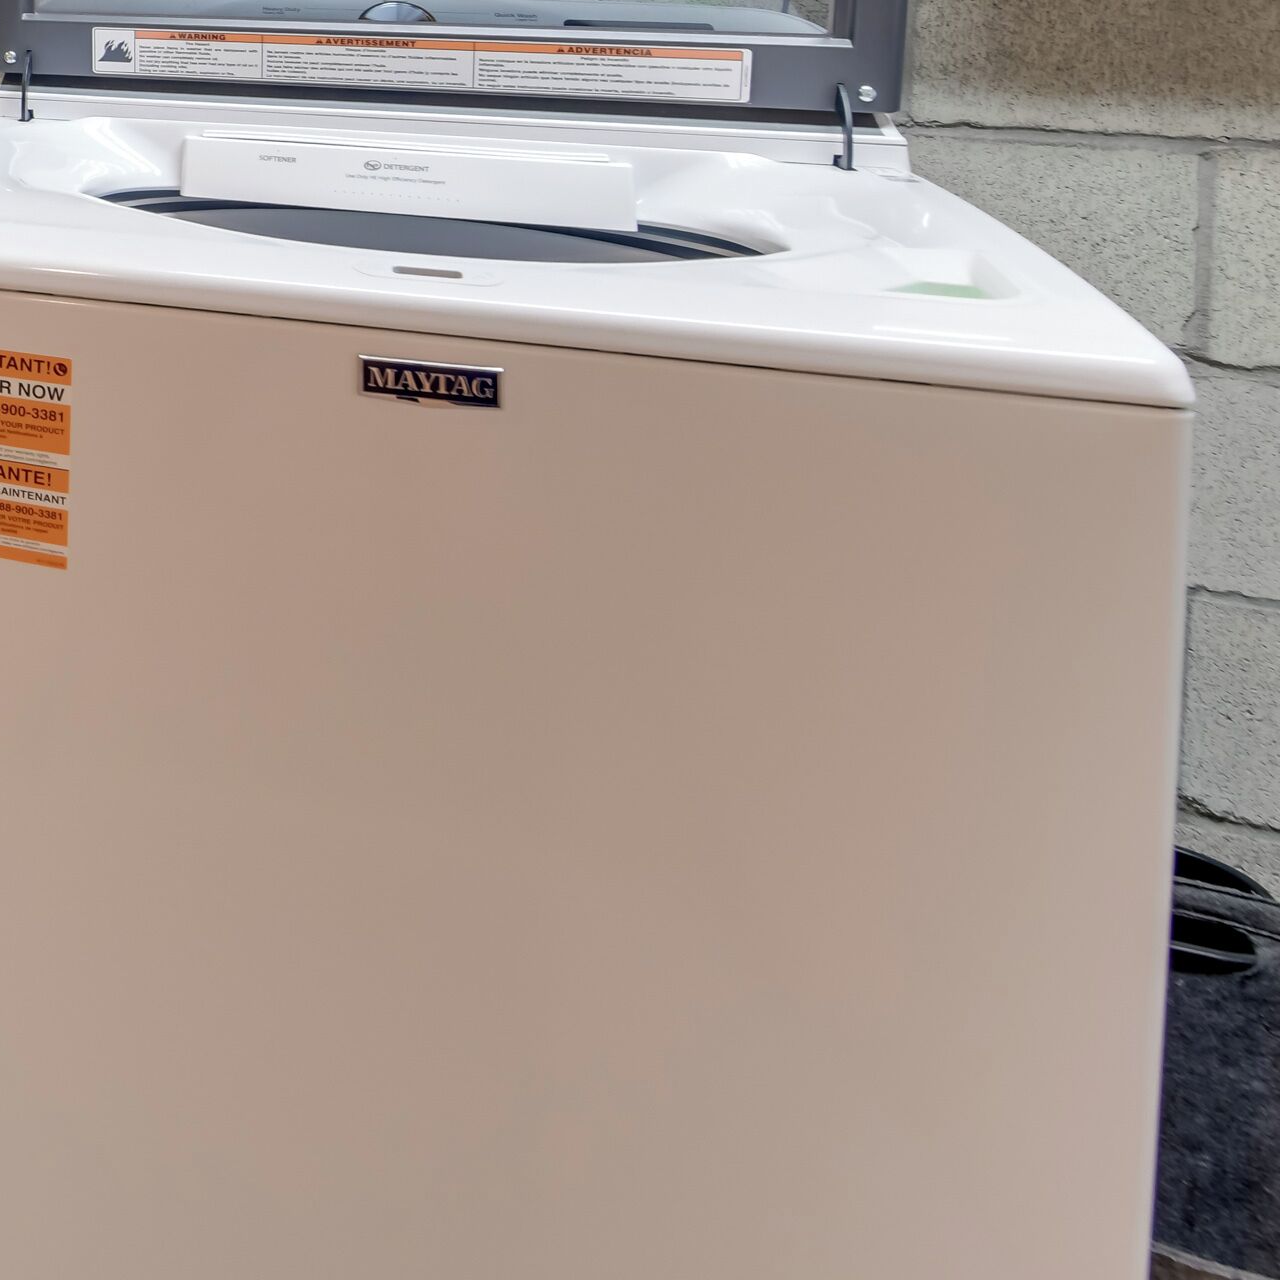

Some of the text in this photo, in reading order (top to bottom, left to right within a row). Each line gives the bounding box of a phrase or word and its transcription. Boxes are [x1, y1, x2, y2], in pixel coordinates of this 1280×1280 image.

[178, 32, 226, 41] WARNING
[325, 38, 417, 48] AVERTISSEMENT
[566, 46, 652, 57] ADVERTENCIA
[259, 154, 297, 163] SOFTENER
[383, 163, 430, 172] DETERGENT
[367, 366, 494, 399] MAYTAG
[18, 382, 65, 401] NOW
[0, 420, 23, 430] YOUR
[25, 424, 65, 435] PRODUCT
